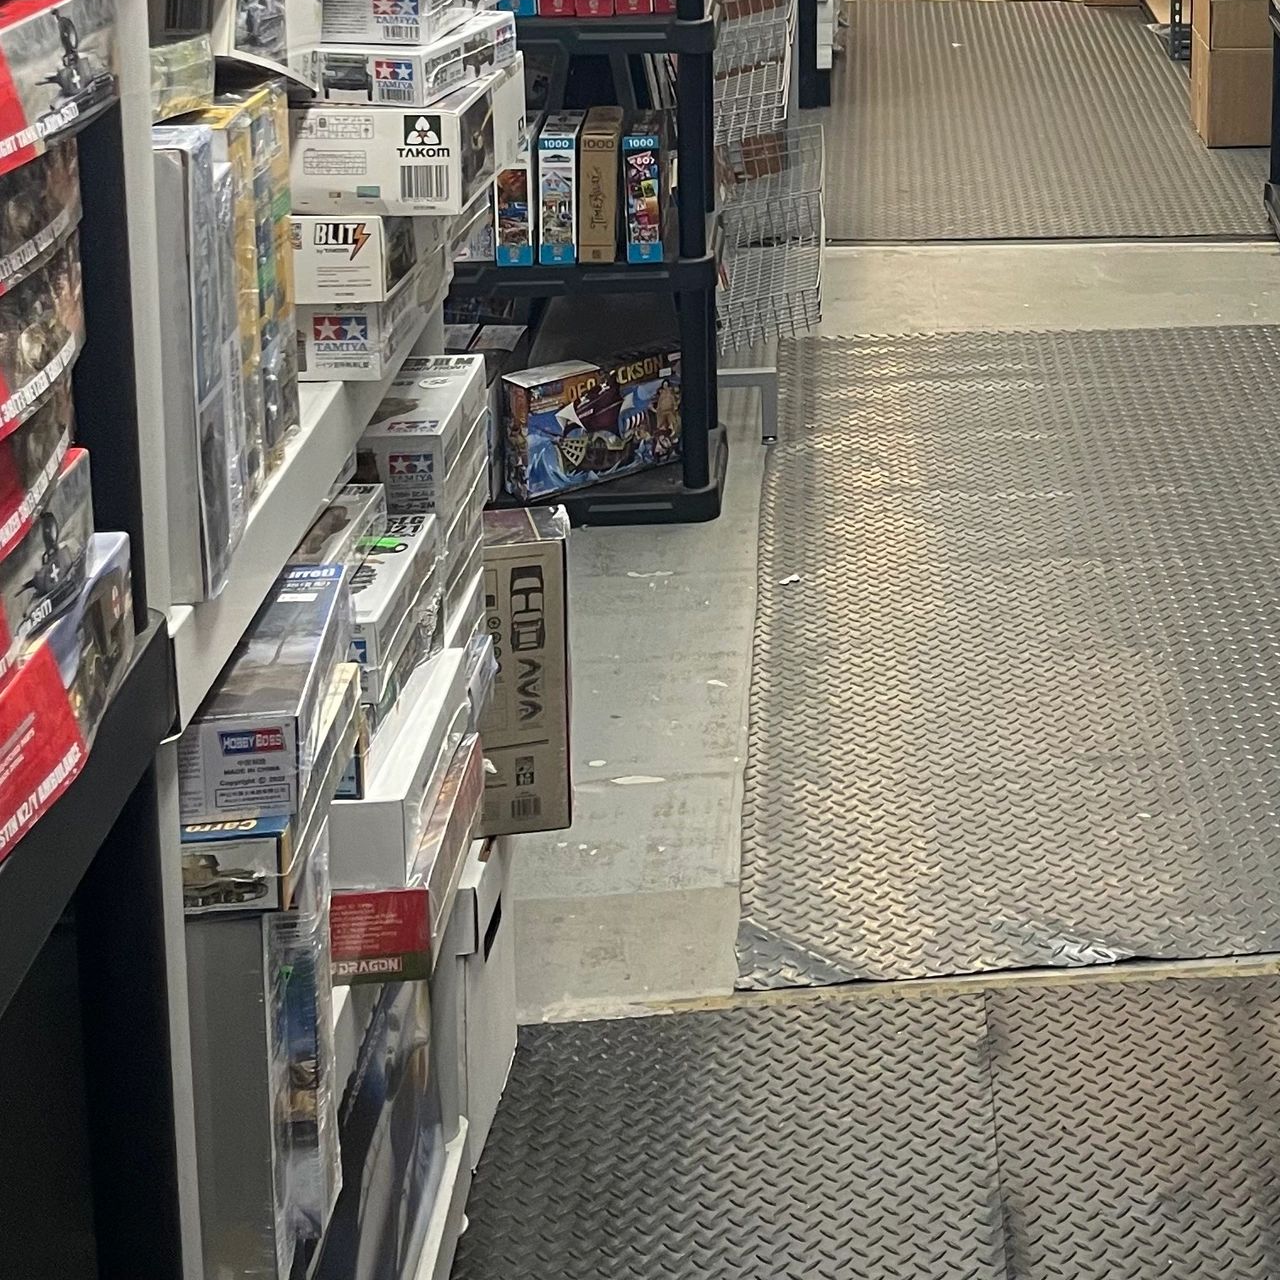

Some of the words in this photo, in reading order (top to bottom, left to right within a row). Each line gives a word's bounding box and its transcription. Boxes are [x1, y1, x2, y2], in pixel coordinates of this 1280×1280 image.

[375, 16, 419, 25] TAMIYA
[377, 81, 413, 90] TAMIYA
[544, 140, 569, 148] 1000
[584, 139, 614, 149] 1000
[629, 138, 654, 147] 1000
[397, 148, 450, 158] TAKOM
[315, 342, 367, 353] TAMIYA
[224, 767, 245, 775] MADE
[219, 777, 255, 786] Copyright
[338, 958, 400, 974] DRAGON
